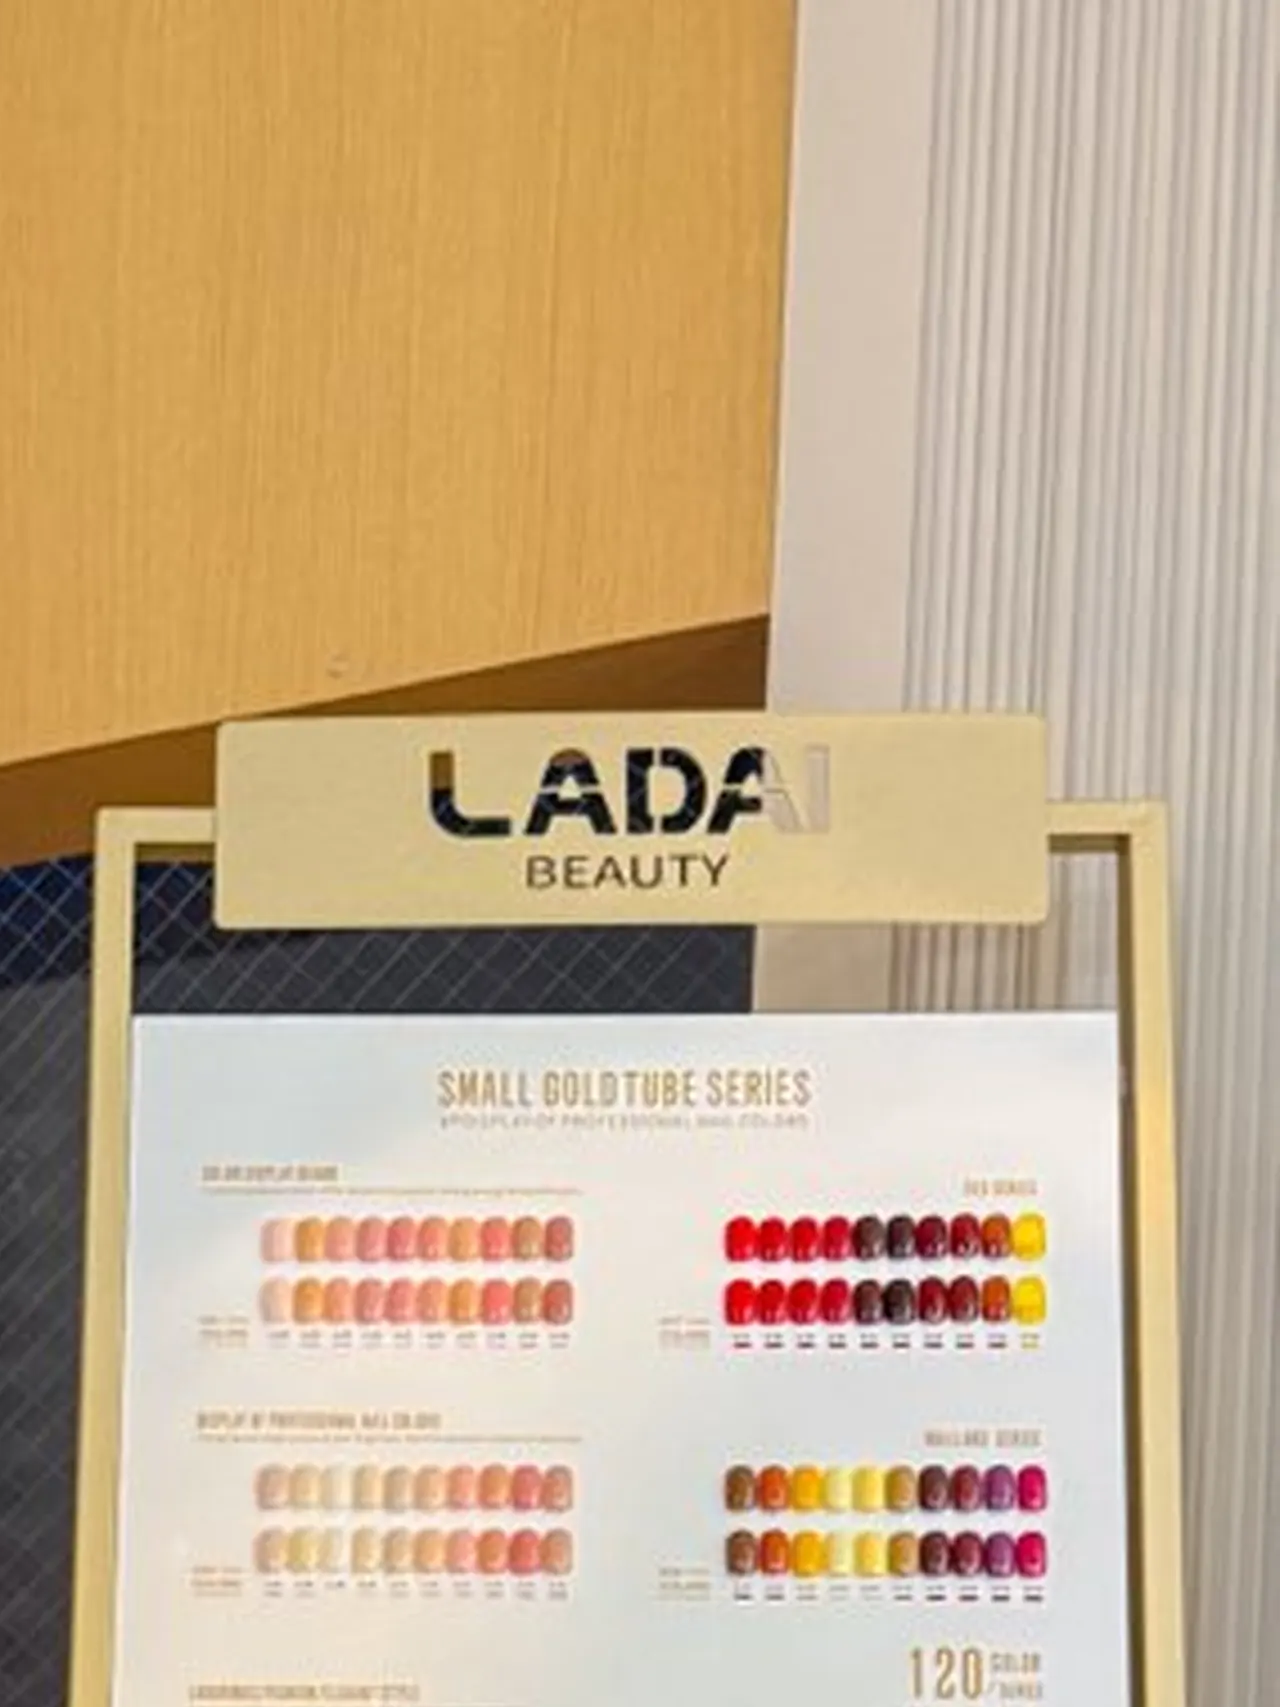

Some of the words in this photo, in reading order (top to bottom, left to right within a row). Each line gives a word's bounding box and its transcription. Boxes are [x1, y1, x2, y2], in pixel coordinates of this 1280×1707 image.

[429, 745, 831, 838] LADAI
[526, 854, 730, 889] BEAUTY
[438, 1070, 532, 1107] SMALL
[706, 1069, 811, 1107] SERIES
[909, 1647, 985, 1701] 120
